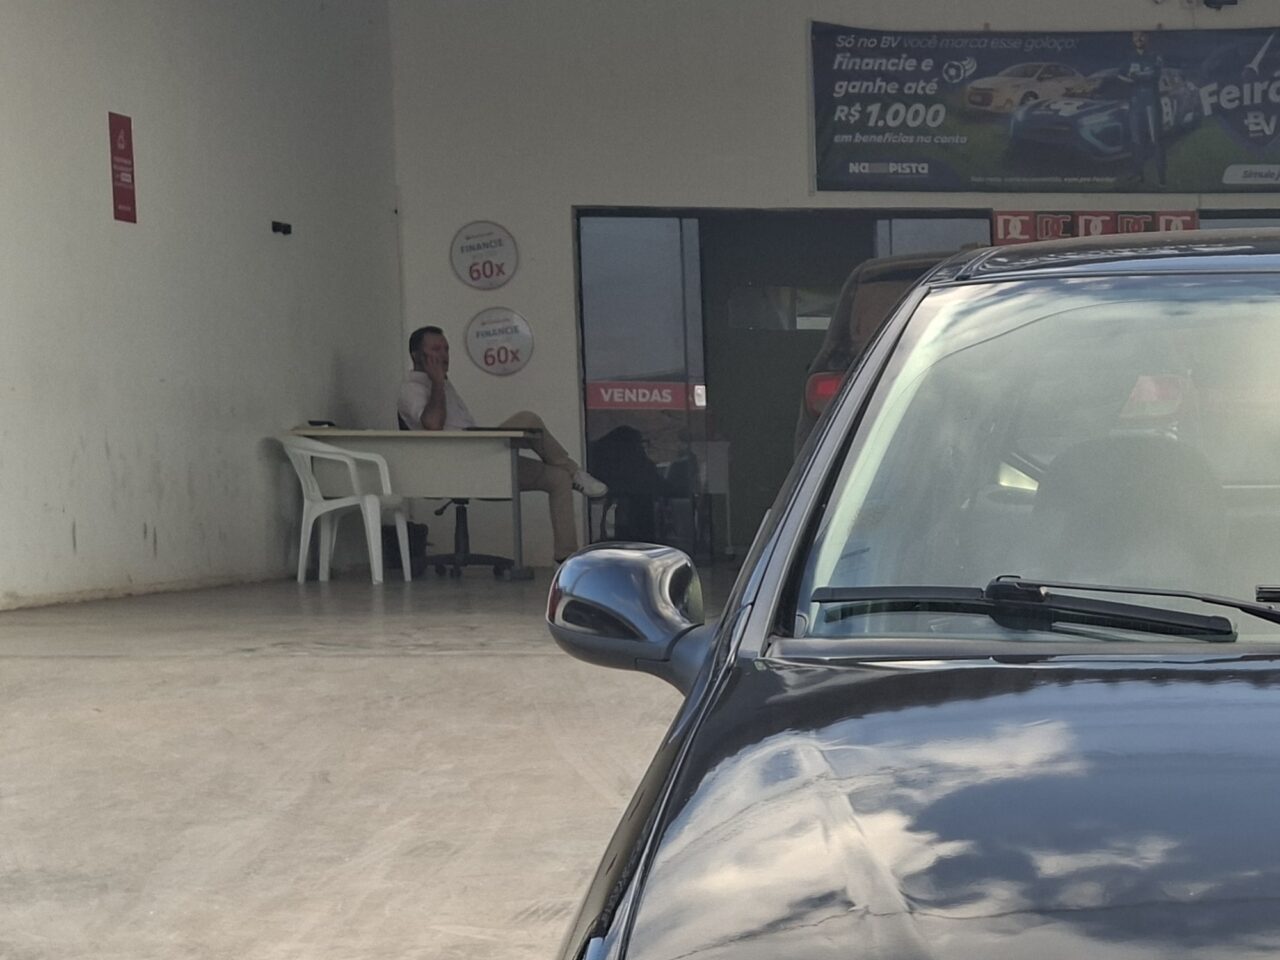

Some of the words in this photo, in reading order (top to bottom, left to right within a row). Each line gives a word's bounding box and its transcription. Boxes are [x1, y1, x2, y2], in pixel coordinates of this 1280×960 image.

[835, 34, 855, 48] Só
[857, 38, 878, 48] no
[880, 36, 902, 48] BV
[903, 36, 938, 48] você
[940, 38, 988, 48] marca
[990, 38, 1020, 48] esse
[833, 53, 916, 71] financie
[920, 58, 934, 71] e
[833, 78, 900, 97] ganhe
[903, 77, 939, 95] até
[833, 105, 861, 124] R$
[864, 103, 946, 127] 1.000
[833, 135, 853, 144] em
[916, 136, 931, 144] na
[933, 136, 968, 144] conta
[469, 260, 506, 281] 60x
[484, 346, 521, 367] 60x
[600, 387, 673, 403] VENDAS
